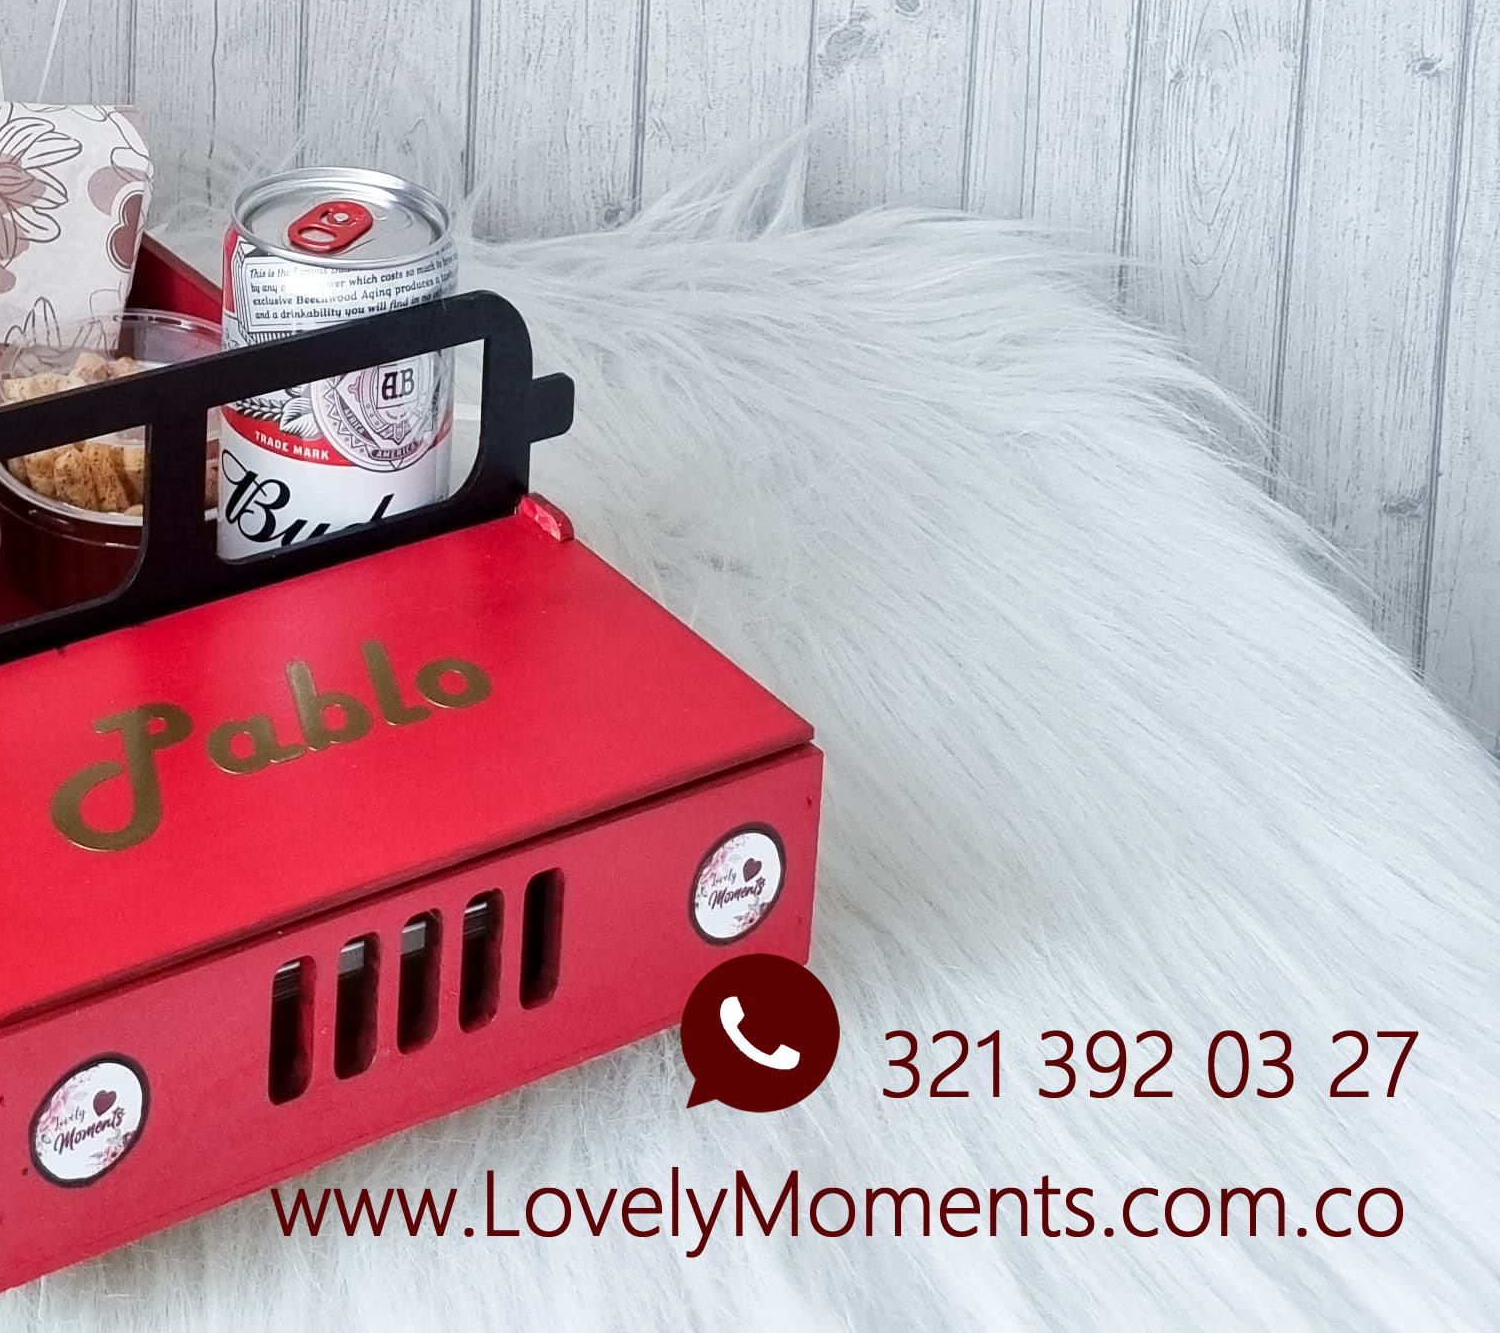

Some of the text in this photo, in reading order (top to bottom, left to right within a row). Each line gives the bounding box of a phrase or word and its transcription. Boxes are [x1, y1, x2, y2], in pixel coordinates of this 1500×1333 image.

[252, 295, 293, 306] exclusive
[361, 288, 392, 301] Aging
[395, 277, 435, 295] produces
[349, 275, 378, 286] which
[380, 270, 403, 283] costs
[405, 268, 415, 278] so
[254, 310, 271, 320] and
[280, 307, 342, 320] drinkability
[344, 305, 365, 318] you
[367, 300, 388, 312] will
[343, 406, 366, 435] AFRICA
[254, 429, 331, 462] TRADE MARK
[375, 439, 420, 459] AMERICA
[49, 638, 493, 854] Pablo
[707, 876, 767, 910] Moments
[53, 1106, 127, 1155] Moments
